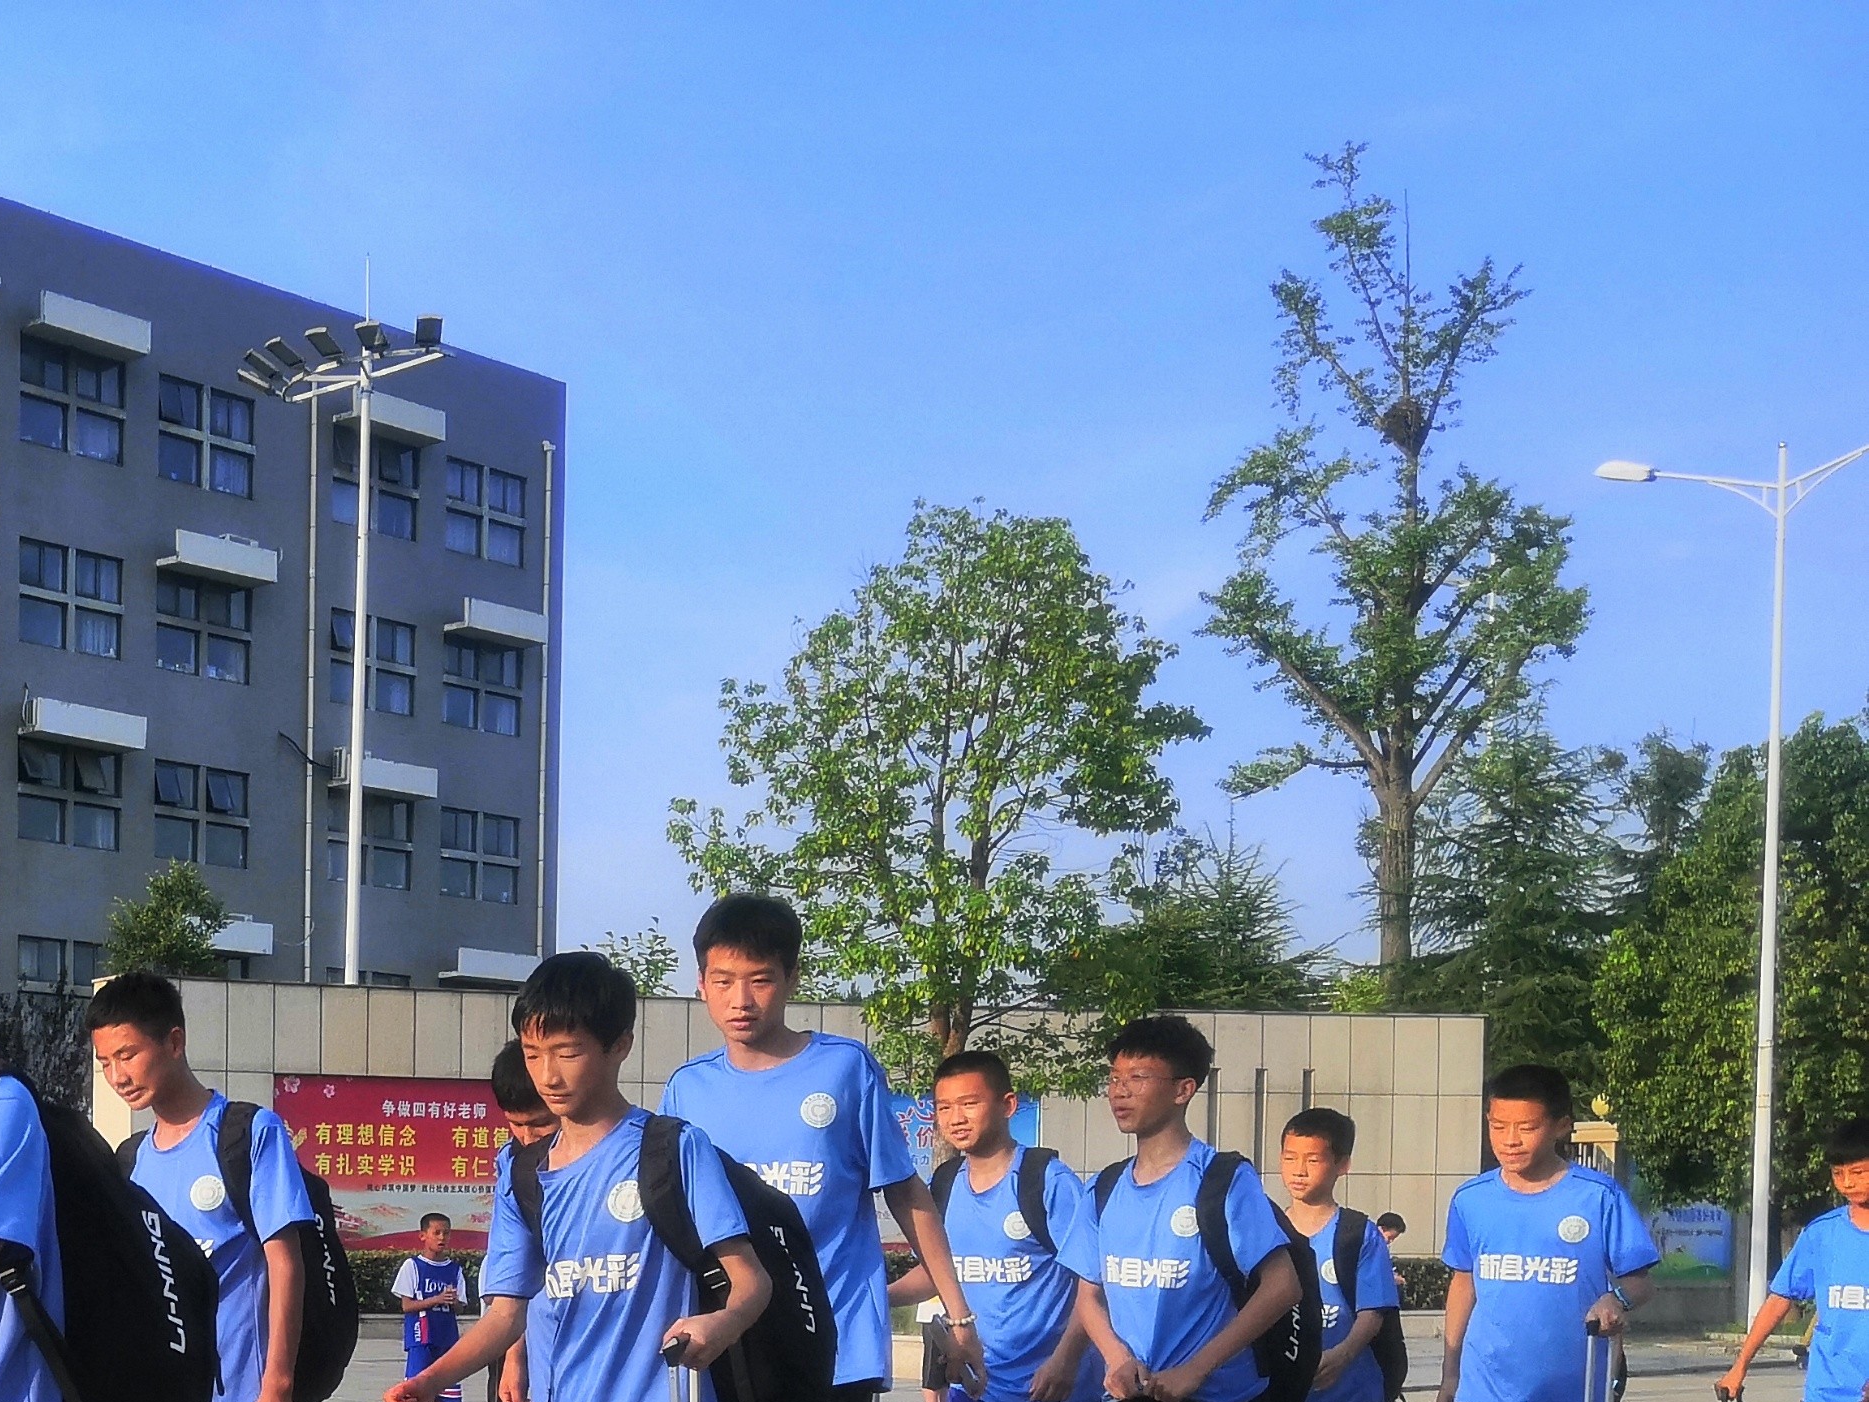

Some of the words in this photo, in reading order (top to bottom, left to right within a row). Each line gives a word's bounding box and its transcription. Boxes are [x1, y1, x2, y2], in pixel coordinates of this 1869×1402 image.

[382, 1100, 488, 1119] 争做四有好老师
[315, 1122, 417, 1147] 有理想信念
[315, 1152, 417, 1177] 有扎实学识
[451, 1156, 498, 1178] 有仁
[142, 1209, 187, 1355] LI-NING
[1479, 1254, 1579, 1284] 新县光彩
